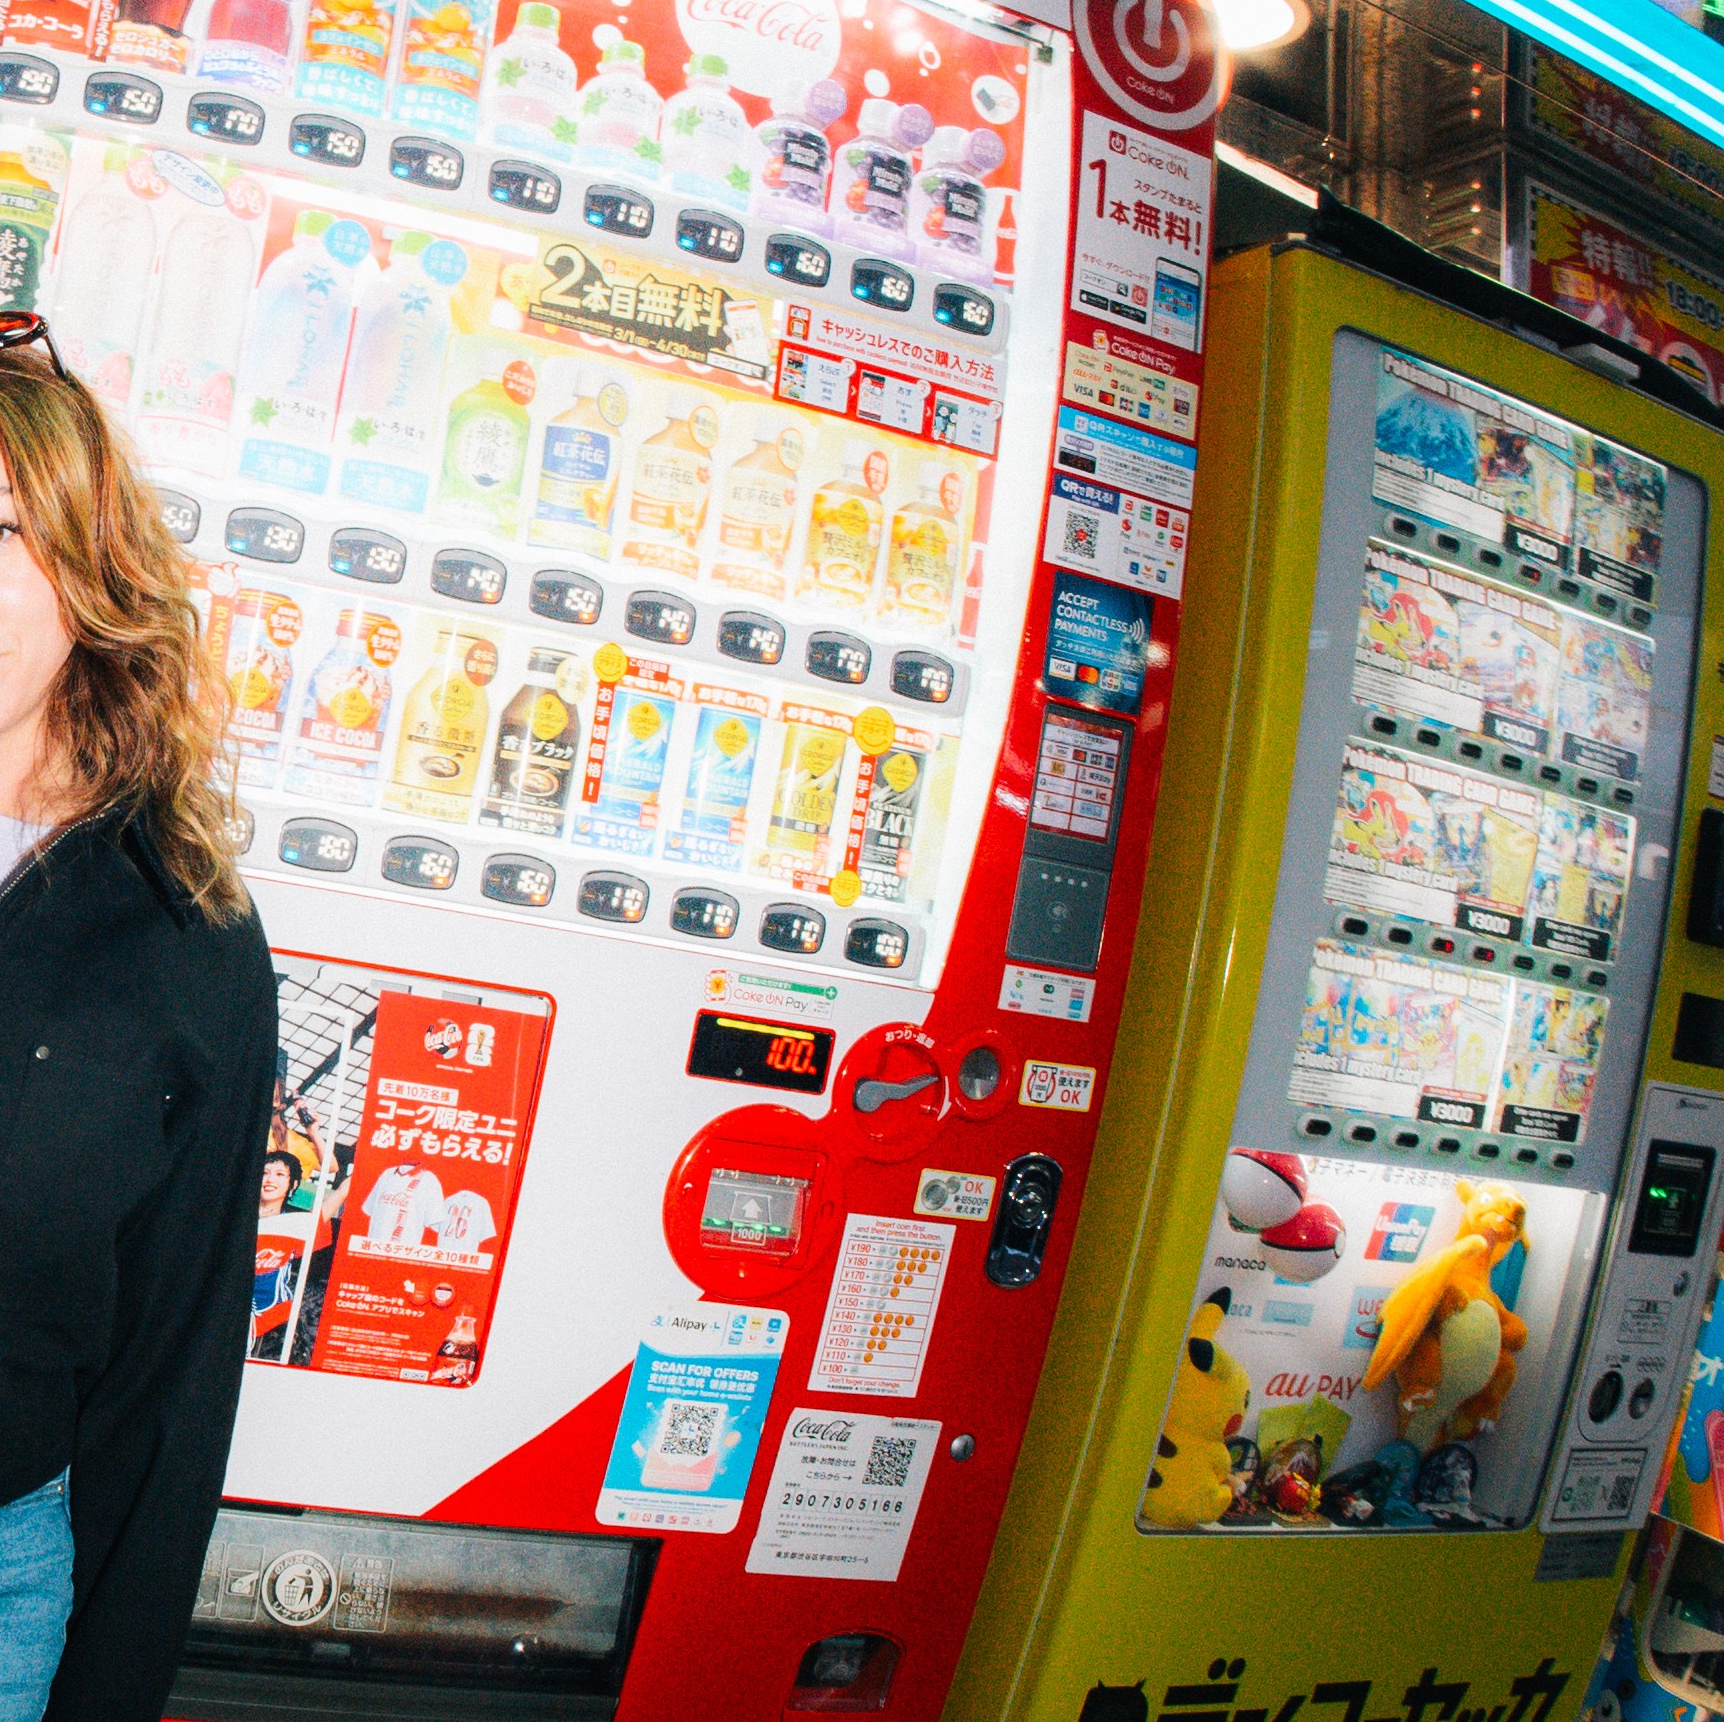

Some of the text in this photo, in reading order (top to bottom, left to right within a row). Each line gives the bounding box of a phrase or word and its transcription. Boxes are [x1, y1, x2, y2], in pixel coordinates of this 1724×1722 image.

[8, 13, 85, 40] コカ・コーラ
[1125, 75, 1154, 98] Coke
[1126, 145, 1166, 171] Coke
[1088, 157, 1204, 256] 1本無料!
[1132, 176, 1204, 214] スタンプたまると
[539, 243, 725, 338] 2本目無料
[821, 318, 996, 384] キャッシュレスでのご購入方法
[1110, 340, 1177, 375] Coke Pay
[1072, 382, 1095, 399] VISA
[1517, 534, 1559, 560] ¥3000
[1058, 589, 1100, 610] ACCEPT
[1054, 618, 1109, 642] PAYMENTS
[1056, 604, 1129, 635] CONTACTLESS
[310, 721, 378, 749] ICE COCOA
[582, 685, 616, 799] お手頃価格!
[1494, 718, 1537, 745] ¥3000
[844, 760, 875, 867] お手頃価格!
[1468, 910, 1511, 934] ¥3000
[732, 986, 764, 1005] Coke
[785, 996, 809, 1014] Pay
[382, 1080, 455, 1102] 先着10万名様
[1058, 1088, 1081, 1106] OK
[374, 1099, 519, 1139] コーク限定ユニ
[1430, 1099, 1473, 1124] ¥3000
[370, 1124, 515, 1166] 必ずもらえる!
[963, 1180, 985, 1196] OK
[735, 1226, 763, 1243] 1000
[359, 1239, 481, 1267] 選べるデザイン全10種類
[1214, 1255, 1267, 1272] manaca
[671, 1316, 709, 1333] Alipay
[650, 1360, 760, 1383] SCAN FOR OFFERS
[1266, 1371, 1363, 1400] au PAY
[791, 1417, 857, 1444] Coca-Cola
[805, 1469, 841, 1481] こちらから
[781, 1491, 904, 1513] 2907305166
